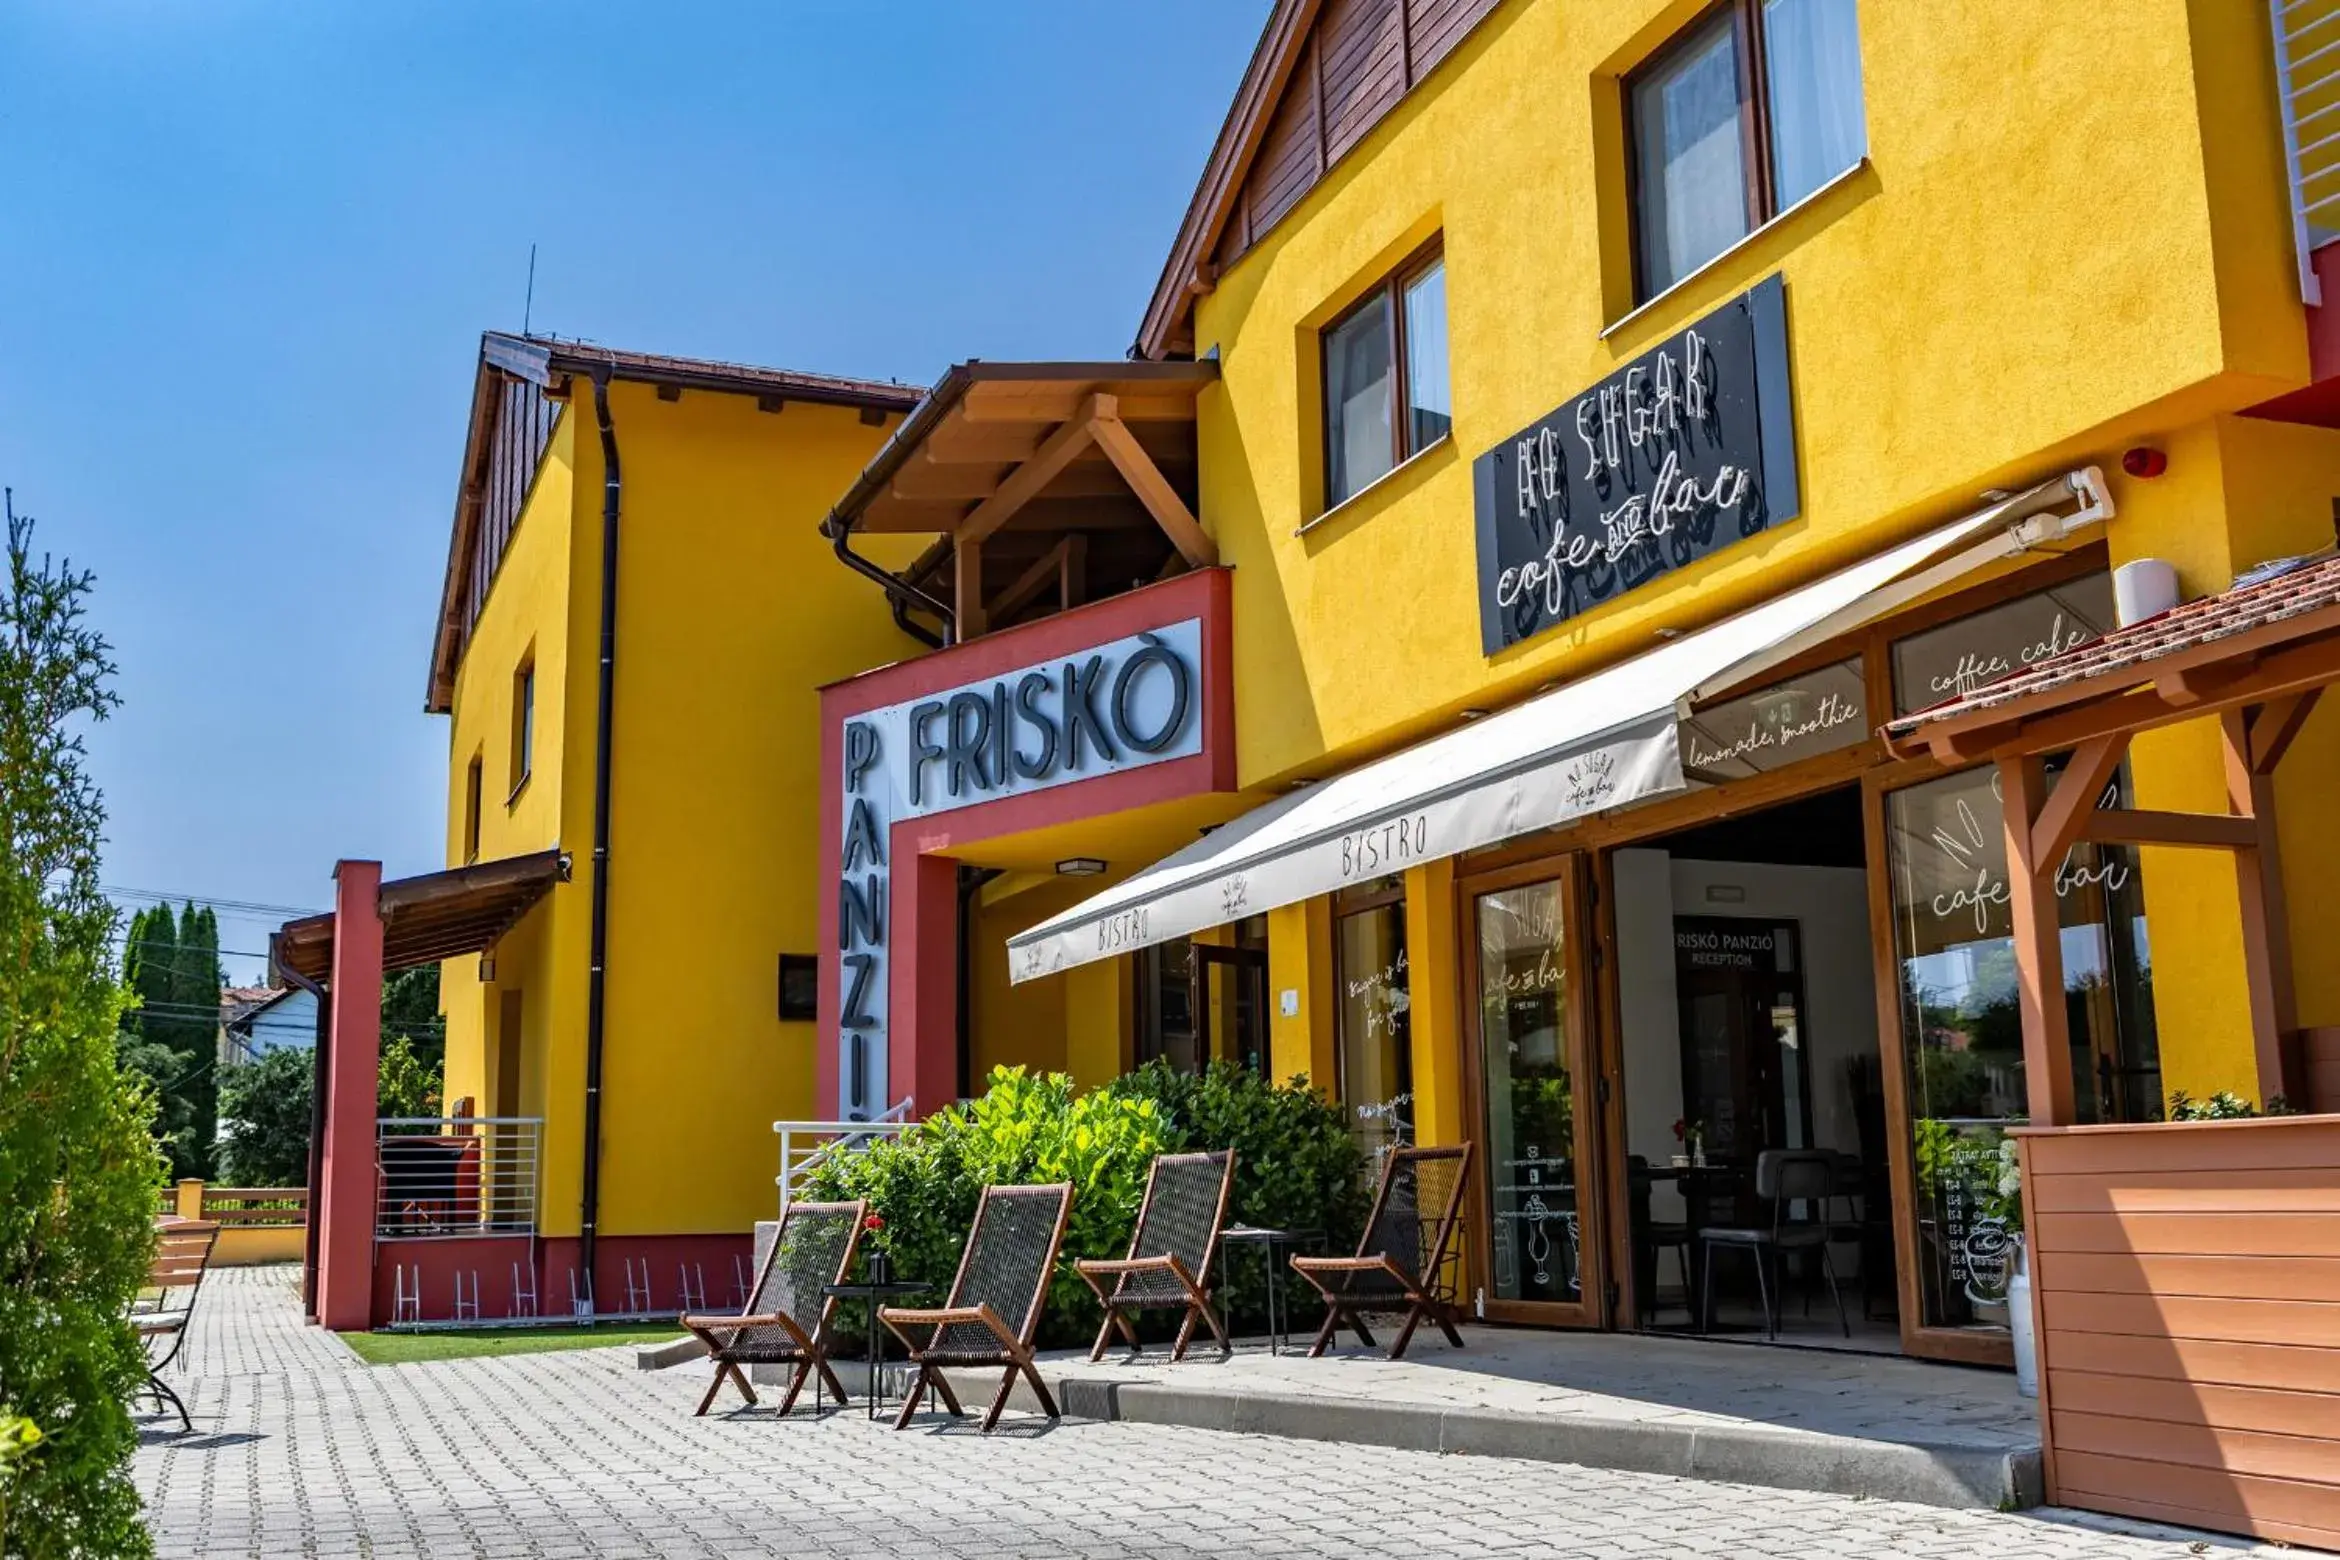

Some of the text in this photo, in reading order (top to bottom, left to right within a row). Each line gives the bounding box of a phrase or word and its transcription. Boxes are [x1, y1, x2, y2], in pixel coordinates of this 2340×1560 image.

[1517, 330, 1704, 517] NO SUGAR
[1497, 519, 1601, 614] cafe
[1650, 450, 1746, 535] bar
[2021, 614, 2087, 662] cake
[1342, 815, 1426, 876] BISTRO
[1931, 799, 1983, 870] NO
[839, 722, 882, 1140] PANZI
[1098, 908, 1149, 951] BISTRO
[1933, 868, 2012, 934] cafe
[1677, 930, 1719, 949] RISKÓ
[1692, 953, 1752, 965] RECEPTION
